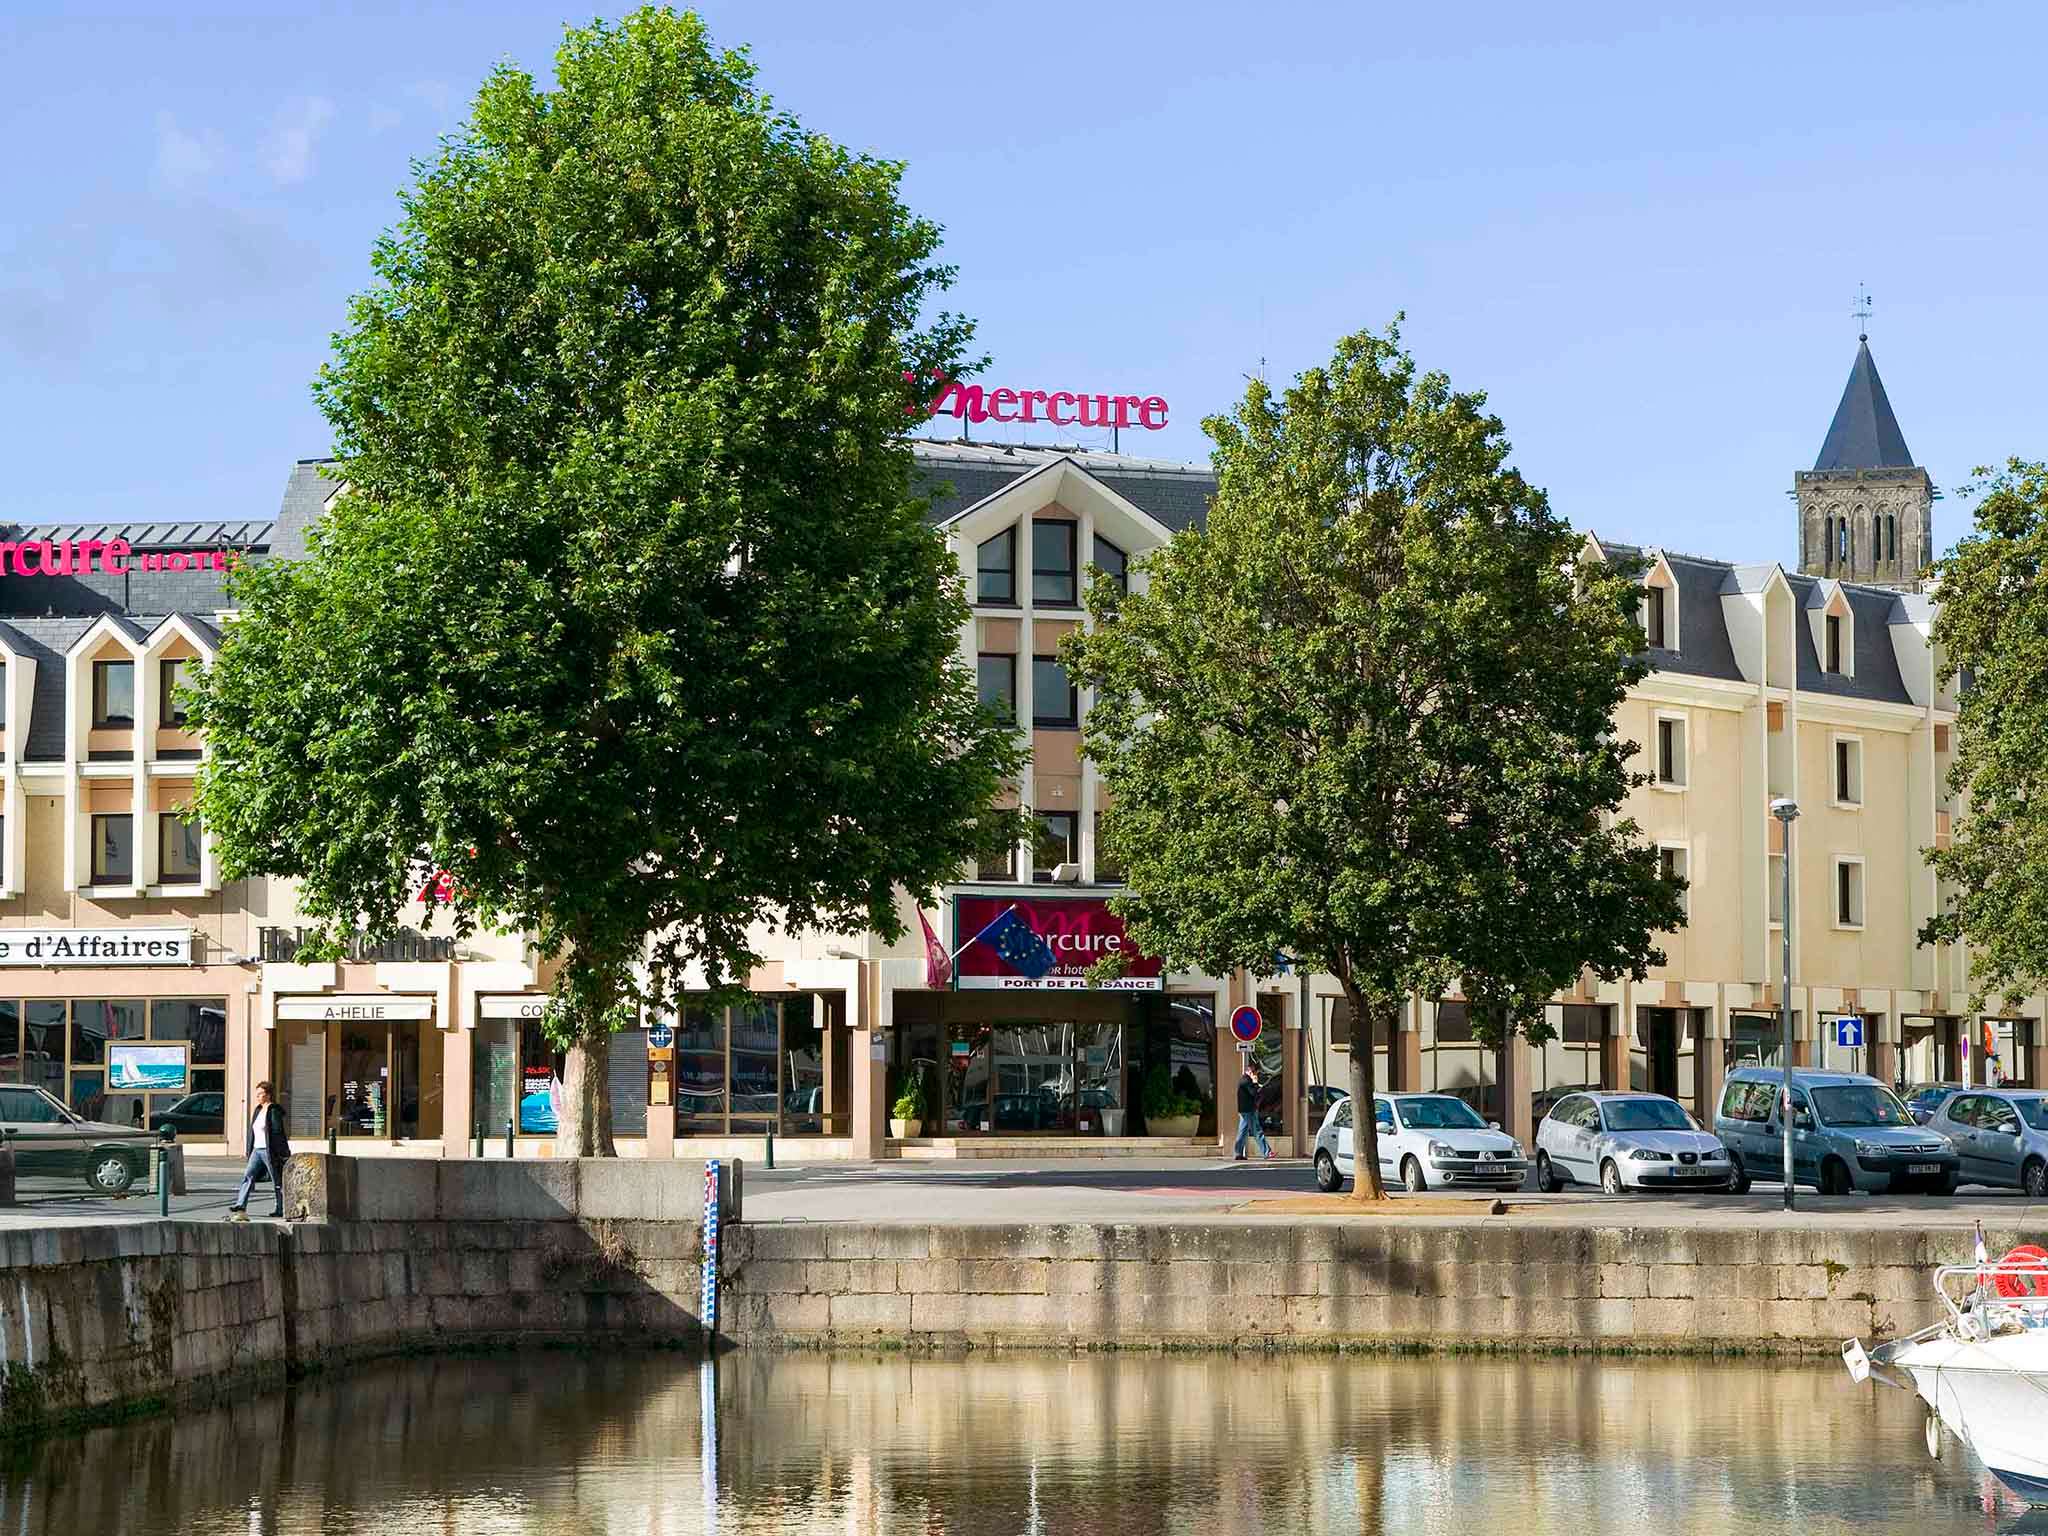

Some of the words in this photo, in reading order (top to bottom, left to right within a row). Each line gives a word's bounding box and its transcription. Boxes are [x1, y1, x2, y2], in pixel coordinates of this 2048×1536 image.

[25, 935, 181, 958] d'Affaires
[1003, 979, 1039, 988] PORT
[1048, 980, 1065, 988] DE
[1074, 980, 1156, 989] PLISANCE
[324, 1006, 385, 1019] A-HELIE
